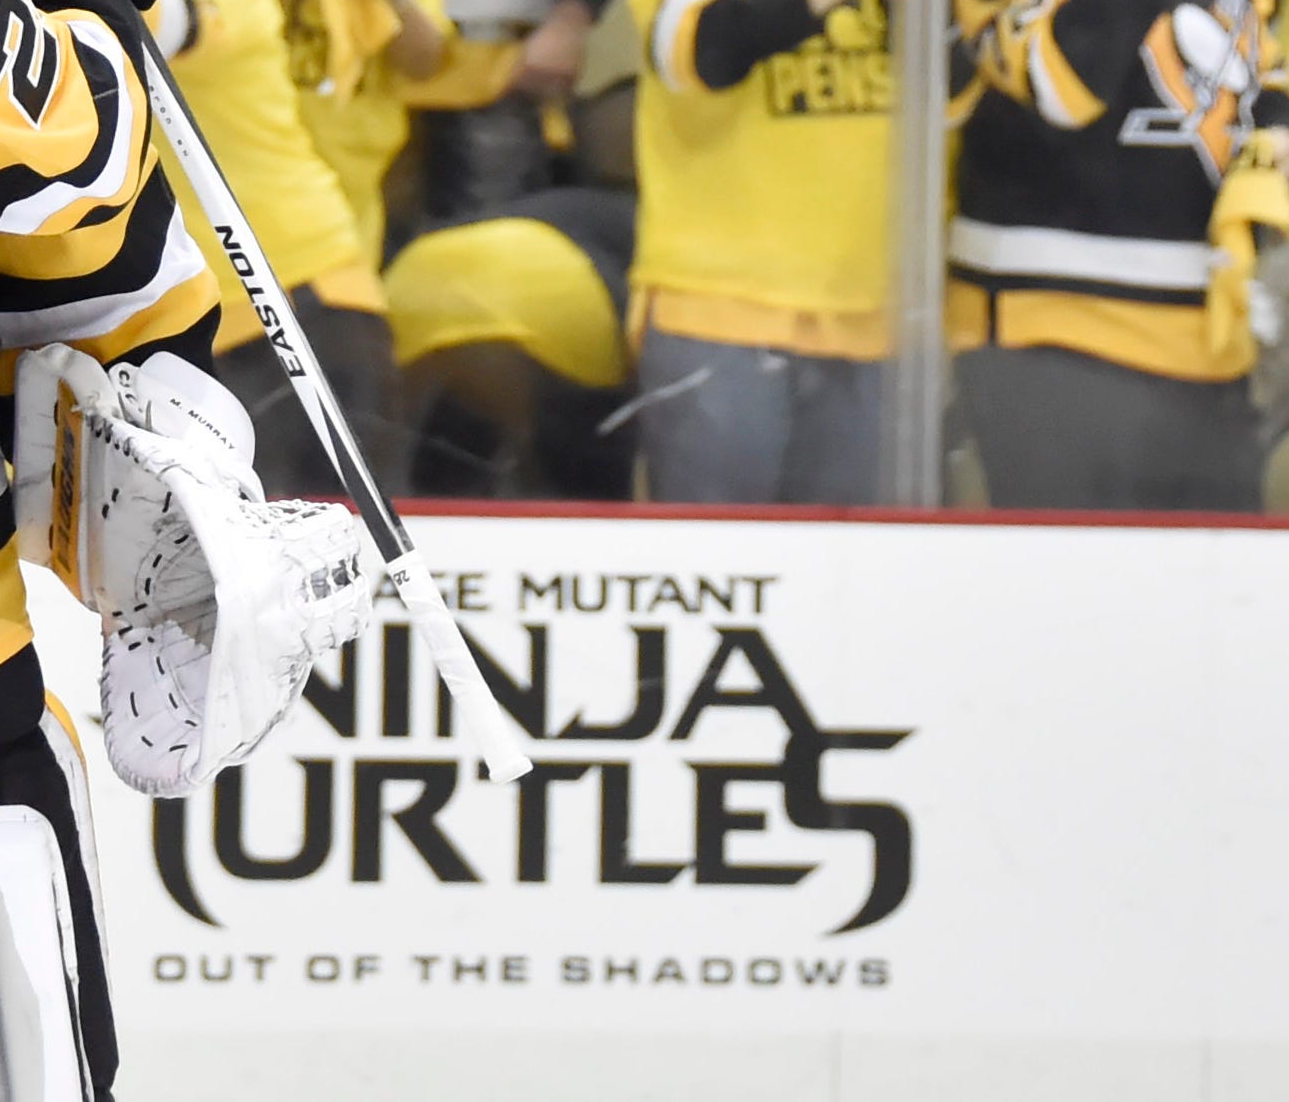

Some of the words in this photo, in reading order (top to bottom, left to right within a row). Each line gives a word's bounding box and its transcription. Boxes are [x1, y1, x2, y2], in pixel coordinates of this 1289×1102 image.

[214, 225, 306, 377] EASTON
[188, 410, 235, 450] MURRAY
[519, 573, 780, 614] MUTANT
[154, 954, 275, 982] OUT
[306, 954, 379, 982] OF
[411, 955, 528, 983] THE
[561, 956, 892, 986] SHADOWS
